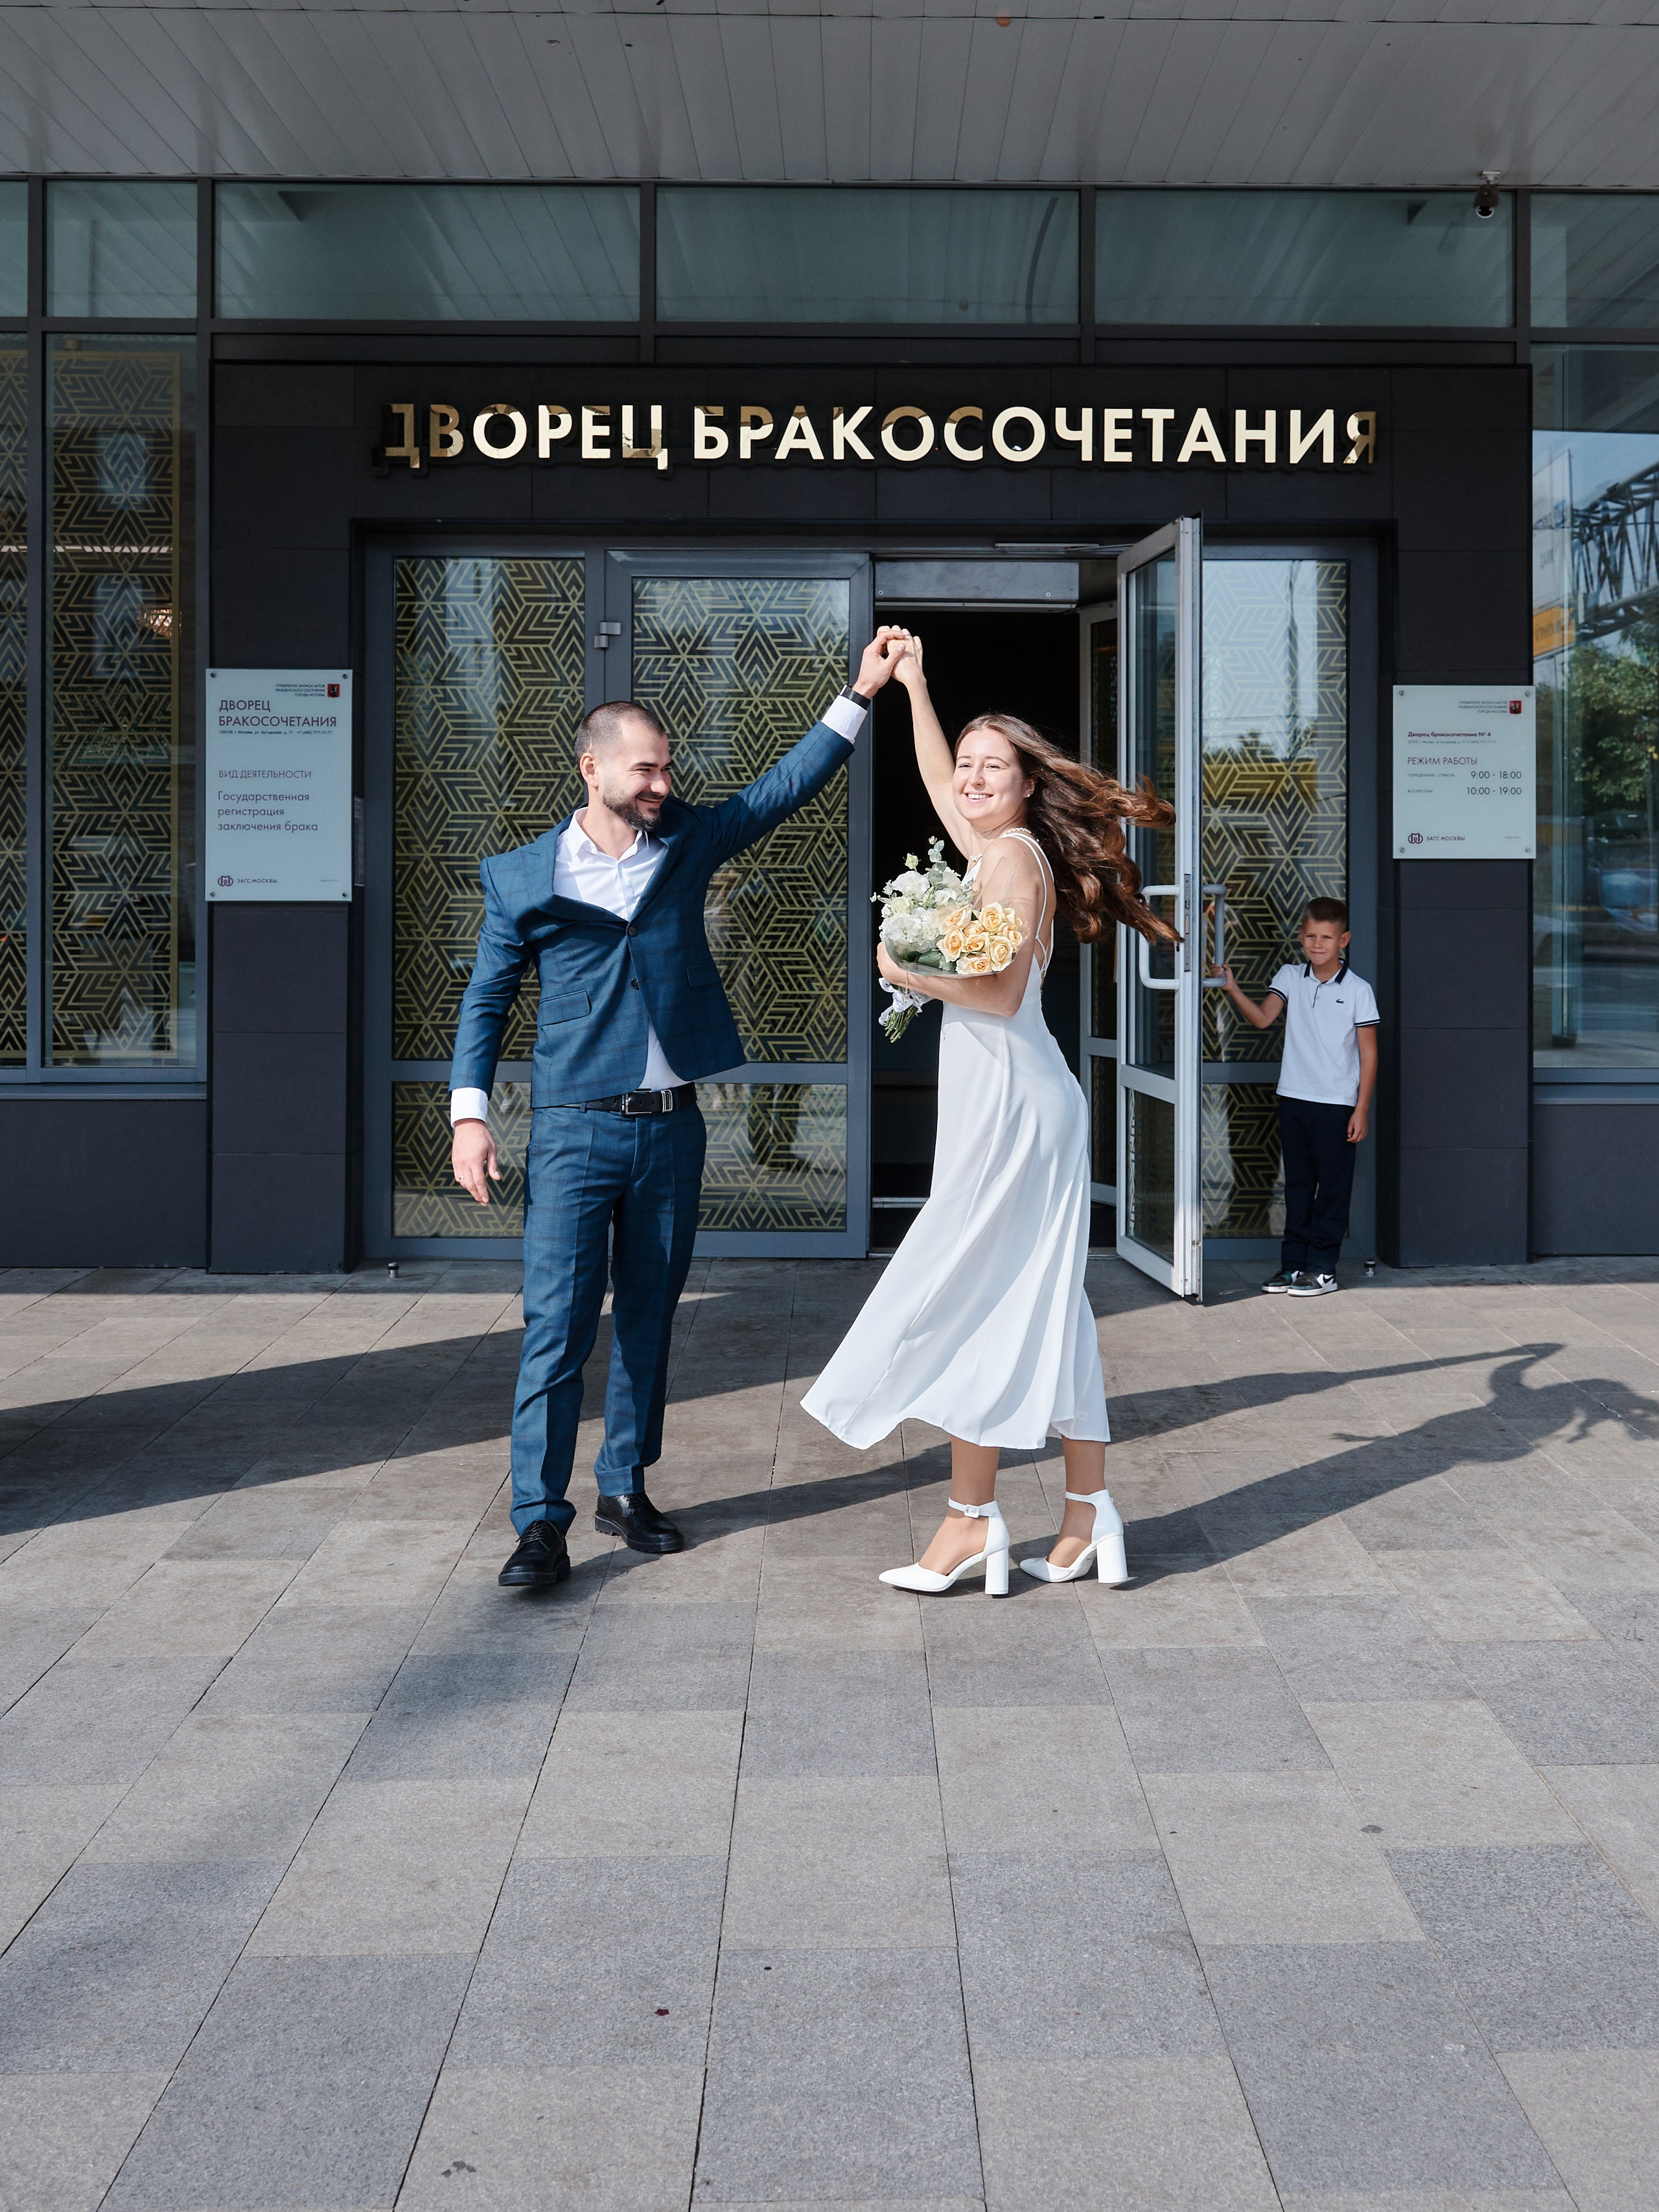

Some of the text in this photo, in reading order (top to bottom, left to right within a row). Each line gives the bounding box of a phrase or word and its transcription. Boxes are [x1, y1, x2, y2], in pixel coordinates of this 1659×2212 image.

[384, 402, 1376, 469] ДВОРЕЦ БРАКОСОЧЕТАНИЯ
[219, 700, 270, 712] ДВОРЕЦ
[219, 716, 336, 727] БРАКОСОЧЕТАНИЯ
[218, 770, 311, 779] ВИД ДЕЯТЕЛЬНОСТИ
[1470, 771, 1490, 779] 9:00
[1499, 771, 1522, 779] 18:00
[1467, 787, 1490, 795] 10:00
[1499, 787, 1522, 795] 19:00
[218, 791, 309, 804] Государственная
[218, 809, 284, 818] регистрация
[284, 820, 318, 833] брака
